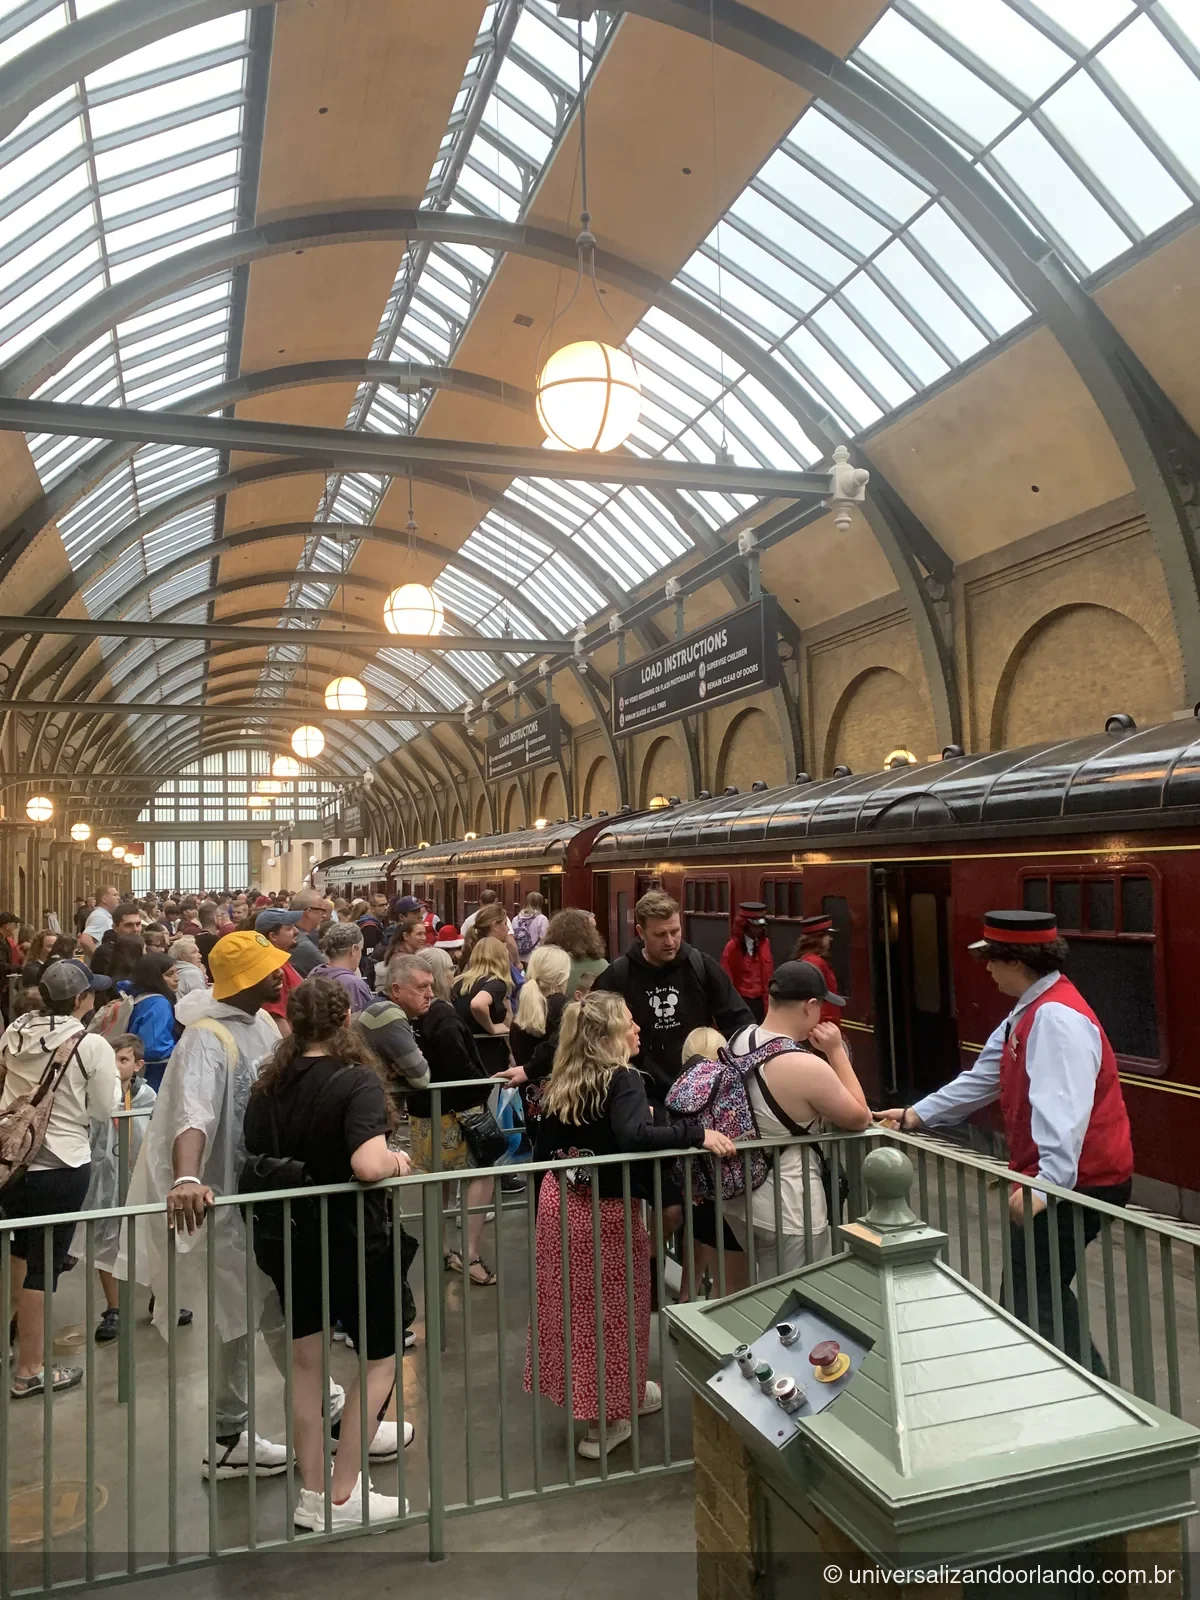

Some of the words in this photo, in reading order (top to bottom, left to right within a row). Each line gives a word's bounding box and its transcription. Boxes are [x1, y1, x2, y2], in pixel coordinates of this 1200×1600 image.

[641, 661, 662, 684] LOAD
[664, 629, 728, 673] INSTRUCTIONS
[706, 656, 727, 671] SUPERVISE
[727, 647, 748, 662] CHILDREN
[670, 669, 697, 686] PHOTOGRAPHY
[707, 678, 722, 690] REMAIN
[722, 673, 736, 684] CLEAR
[736, 669, 743, 679] OF
[743, 663, 759, 677] DOORS
